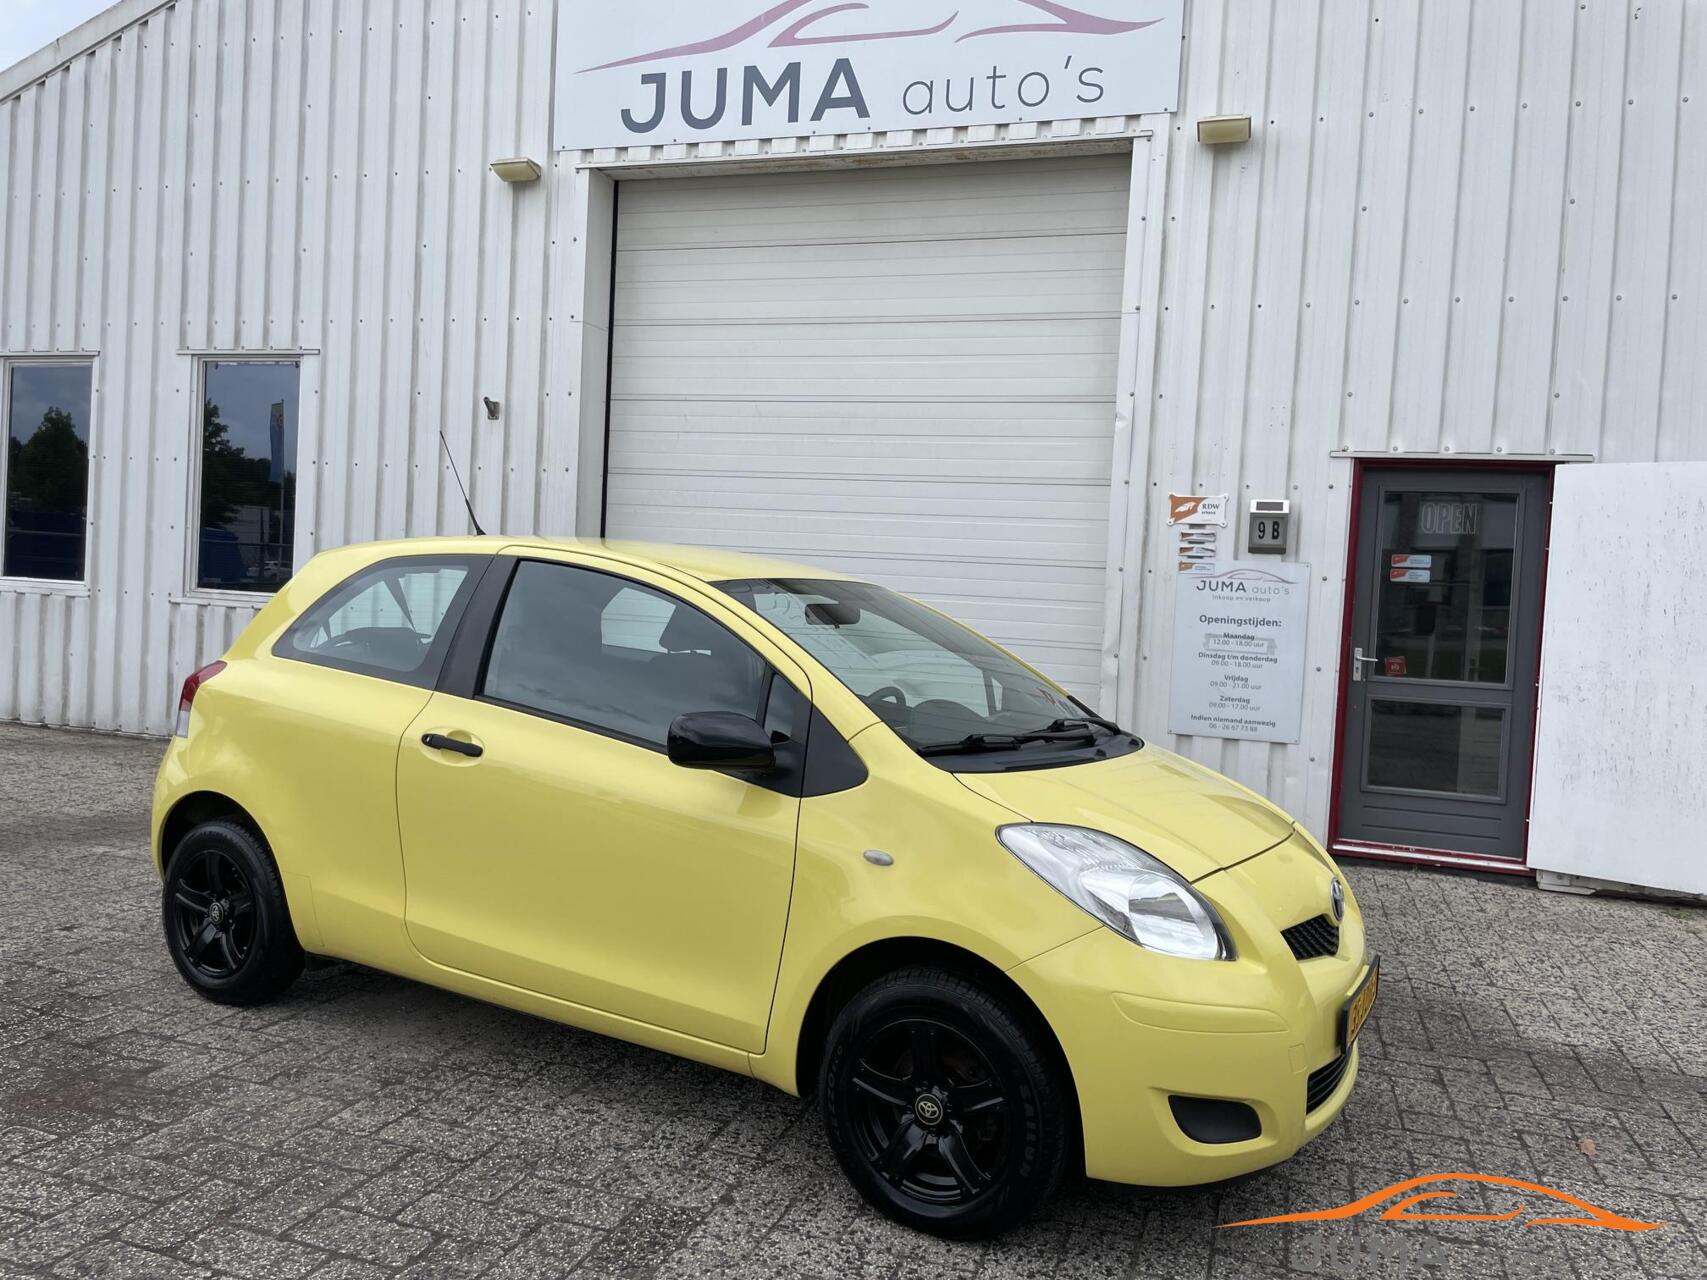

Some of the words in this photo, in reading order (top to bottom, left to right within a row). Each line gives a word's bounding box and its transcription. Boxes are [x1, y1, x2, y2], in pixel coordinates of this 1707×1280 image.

[620, 57, 870, 134] JUMA
[902, 56, 1104, 115] auto's
[1421, 502, 1478, 534] OPEN
[1258, 521, 1265, 539] 9
[1272, 521, 1279, 539] B
[1196, 580, 1247, 593] JUMA
[1252, 587, 1290, 595] auto's
[1199, 615, 1282, 628] Openingstijden:
[1223, 633, 1255, 641] Maandag
[1198, 652, 1226, 660] Dinsdag
[1240, 655, 1278, 664] donderdag
[1224, 675, 1249, 683] Vrijdag
[1219, 695, 1250, 704] Zaterdag
[1213, 716, 1243, 724] niemand
[1244, 719, 1276, 727] aanwezig
